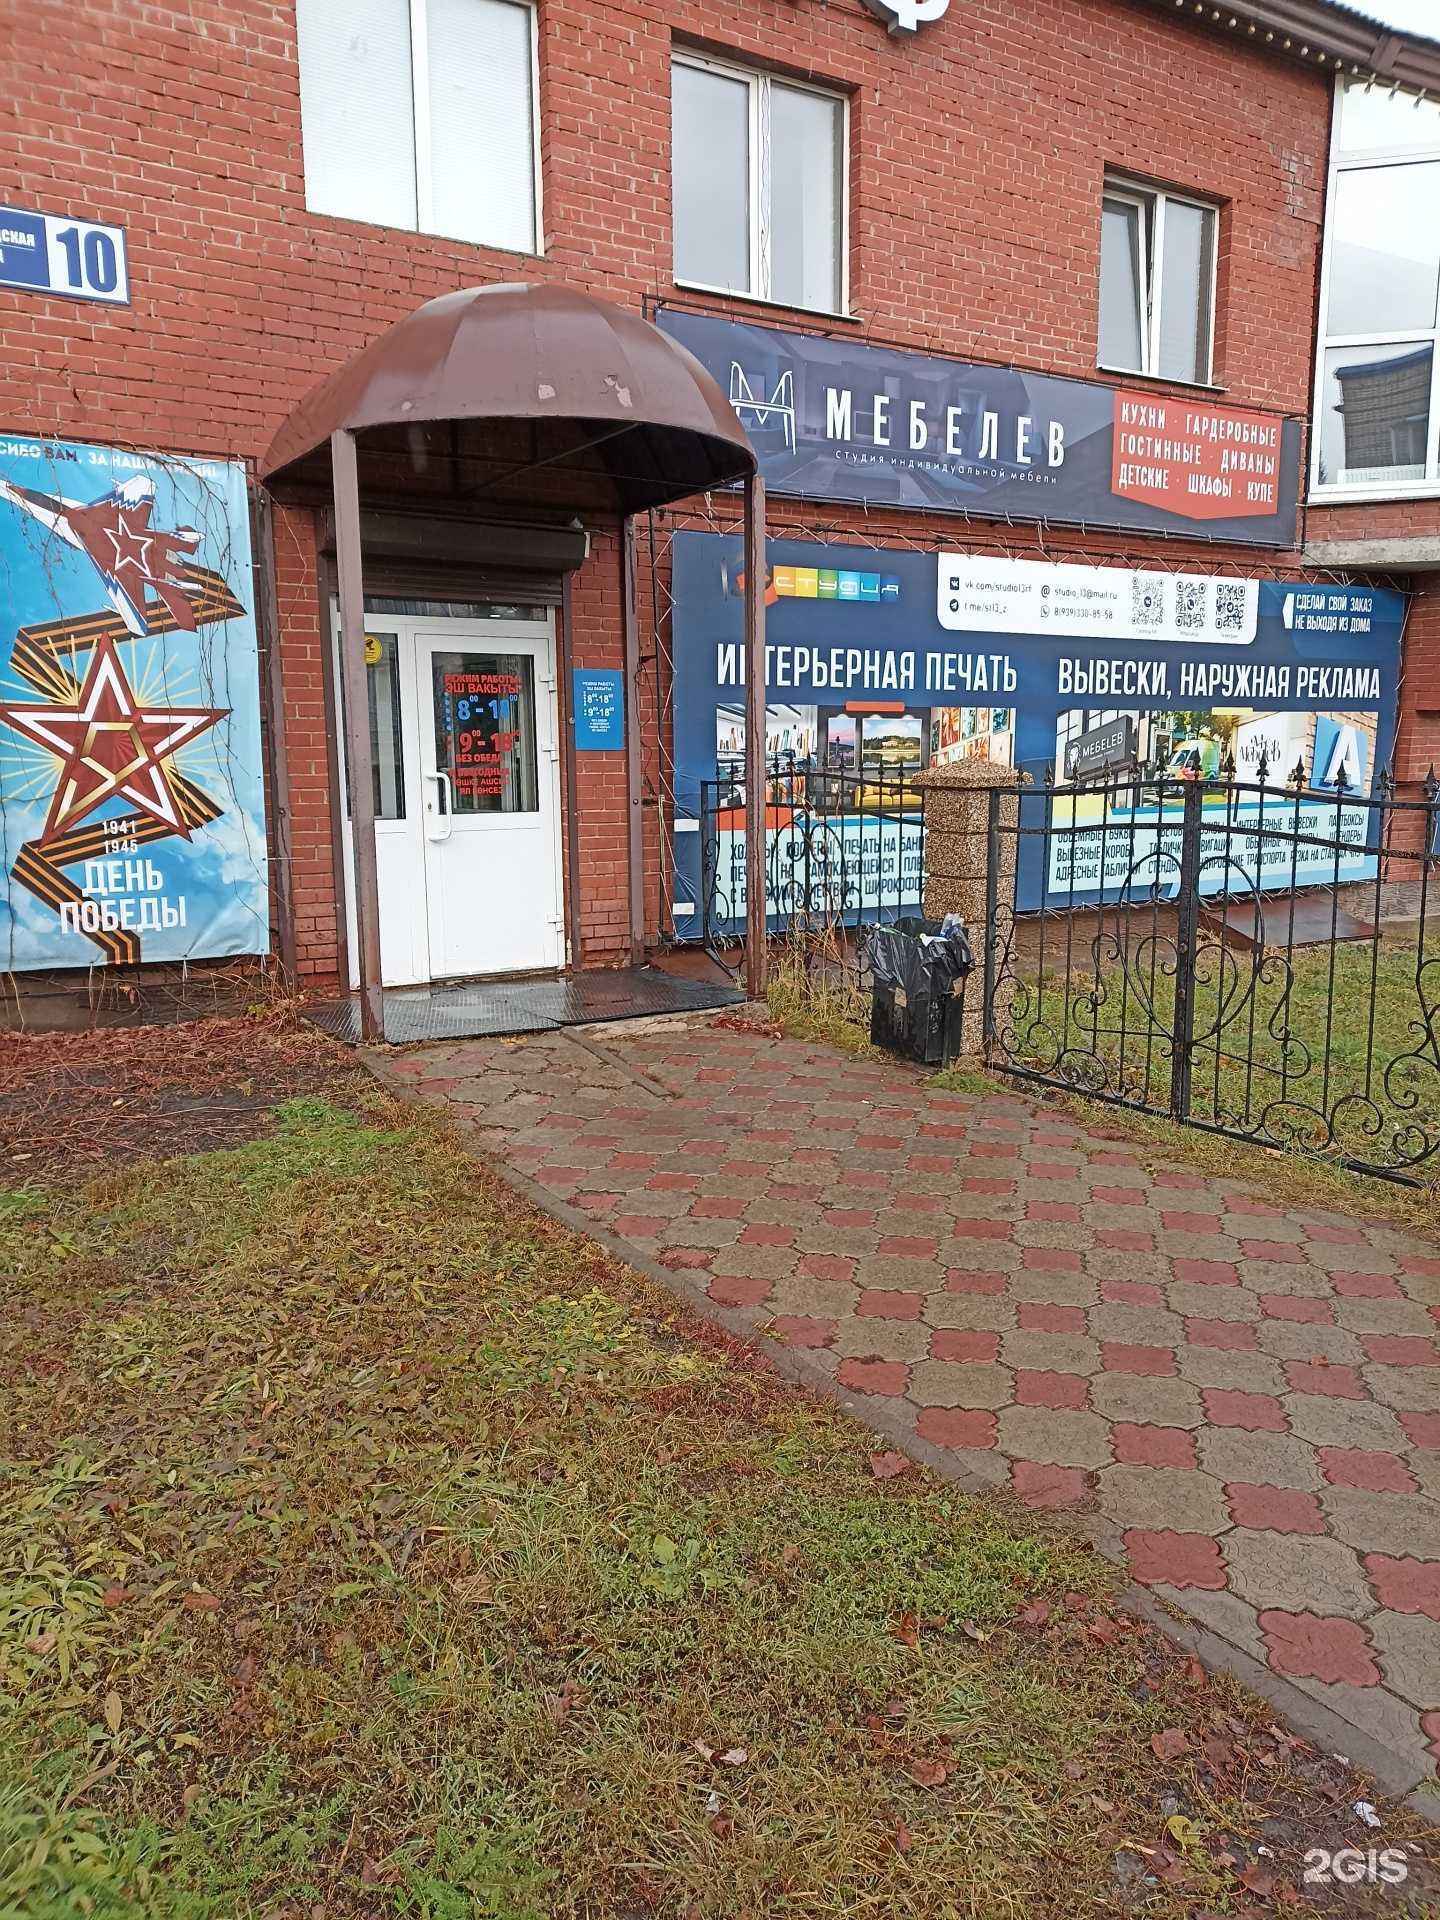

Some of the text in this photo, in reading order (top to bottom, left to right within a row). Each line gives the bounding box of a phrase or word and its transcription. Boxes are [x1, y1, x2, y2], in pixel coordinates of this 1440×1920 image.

[0, 228, 35, 248] СКАЯ
[56, 226, 118, 293] 10
[826, 387, 1065, 467] МЕБЕЛЕВ
[1121, 401, 1277, 447] КУХНИ ГАРДЕРОБНЫЕ
[88, 452, 106, 466] ЗА
[835, 449, 1058, 486] студия индивидуальной мебели
[1120, 432, 1275, 476] ГОСТИННЫЕ ДИВАНЫ
[1118, 463, 1273, 503] ДЕТСКИЕ ШКАФЫ КУПЕ
[1296, 593, 1372, 613] СДЕЛАЙ СВОЙ ЗАКАЗ
[1295, 614, 1371, 633] НЕ ВЫХОДЯ ИЗ ДОМА
[925, 652, 1017, 692] ПЕЧАТЬ
[1058, 658, 1380, 700] ВЫВЕСКИ, НАРУЖНАЯ РЕКЛАМА
[102, 819, 136, 835] 1941
[1328, 813, 1365, 828] ЛАТБОКСЫ
[104, 839, 138, 854] 1945
[884, 838, 896, 852] НА
[900, 836, 924, 852] БАН
[1246, 849, 1286, 866] ТРАСПОРТА
[82, 859, 164, 897] ДЕНЬ
[903, 856, 924, 873] ПЛЕ
[60, 896, 187, 934] ПОБЕДЫ
